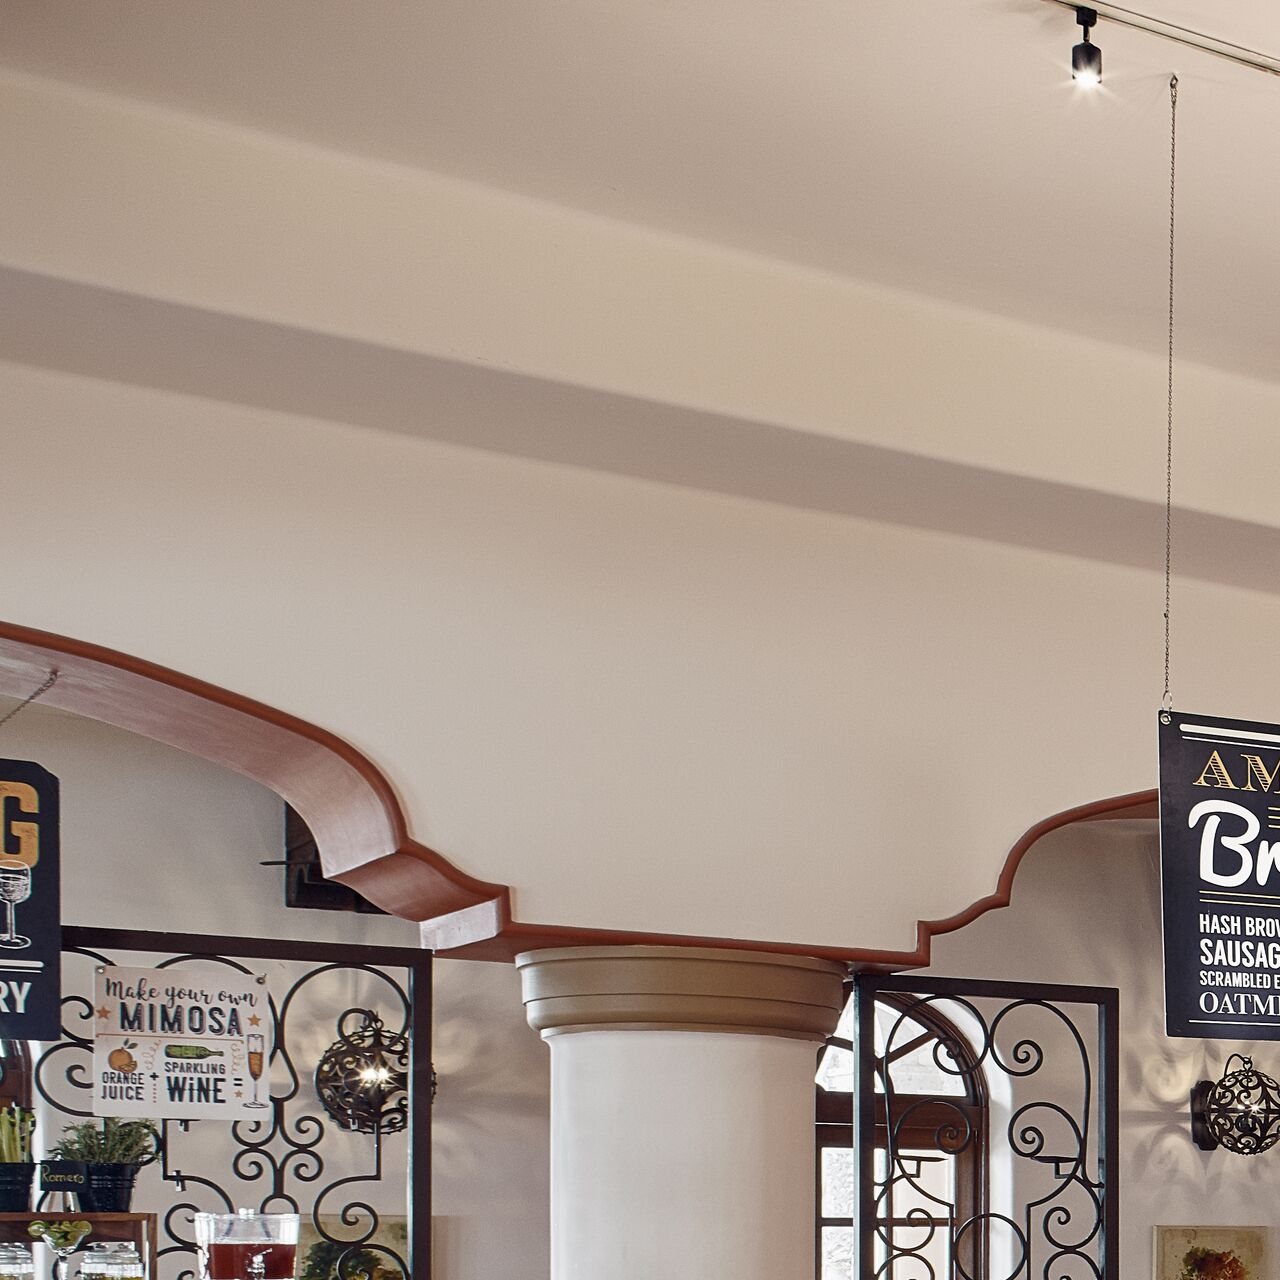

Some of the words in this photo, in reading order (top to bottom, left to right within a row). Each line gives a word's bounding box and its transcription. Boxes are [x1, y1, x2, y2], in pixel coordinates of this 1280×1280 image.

[1199, 914, 1242, 936] HASH
[1200, 971, 1271, 989] SCRAMBLED
[105, 977, 160, 1001] Make
[165, 986, 213, 1009] your
[218, 989, 258, 1007] own
[120, 1002, 244, 1037] MIMOSA
[164, 1062, 226, 1074] SPARKLING
[102, 1072, 144, 1085] ORANGE
[101, 1086, 144, 1100] JUICE
[41, 1165, 84, 1184] Romero
